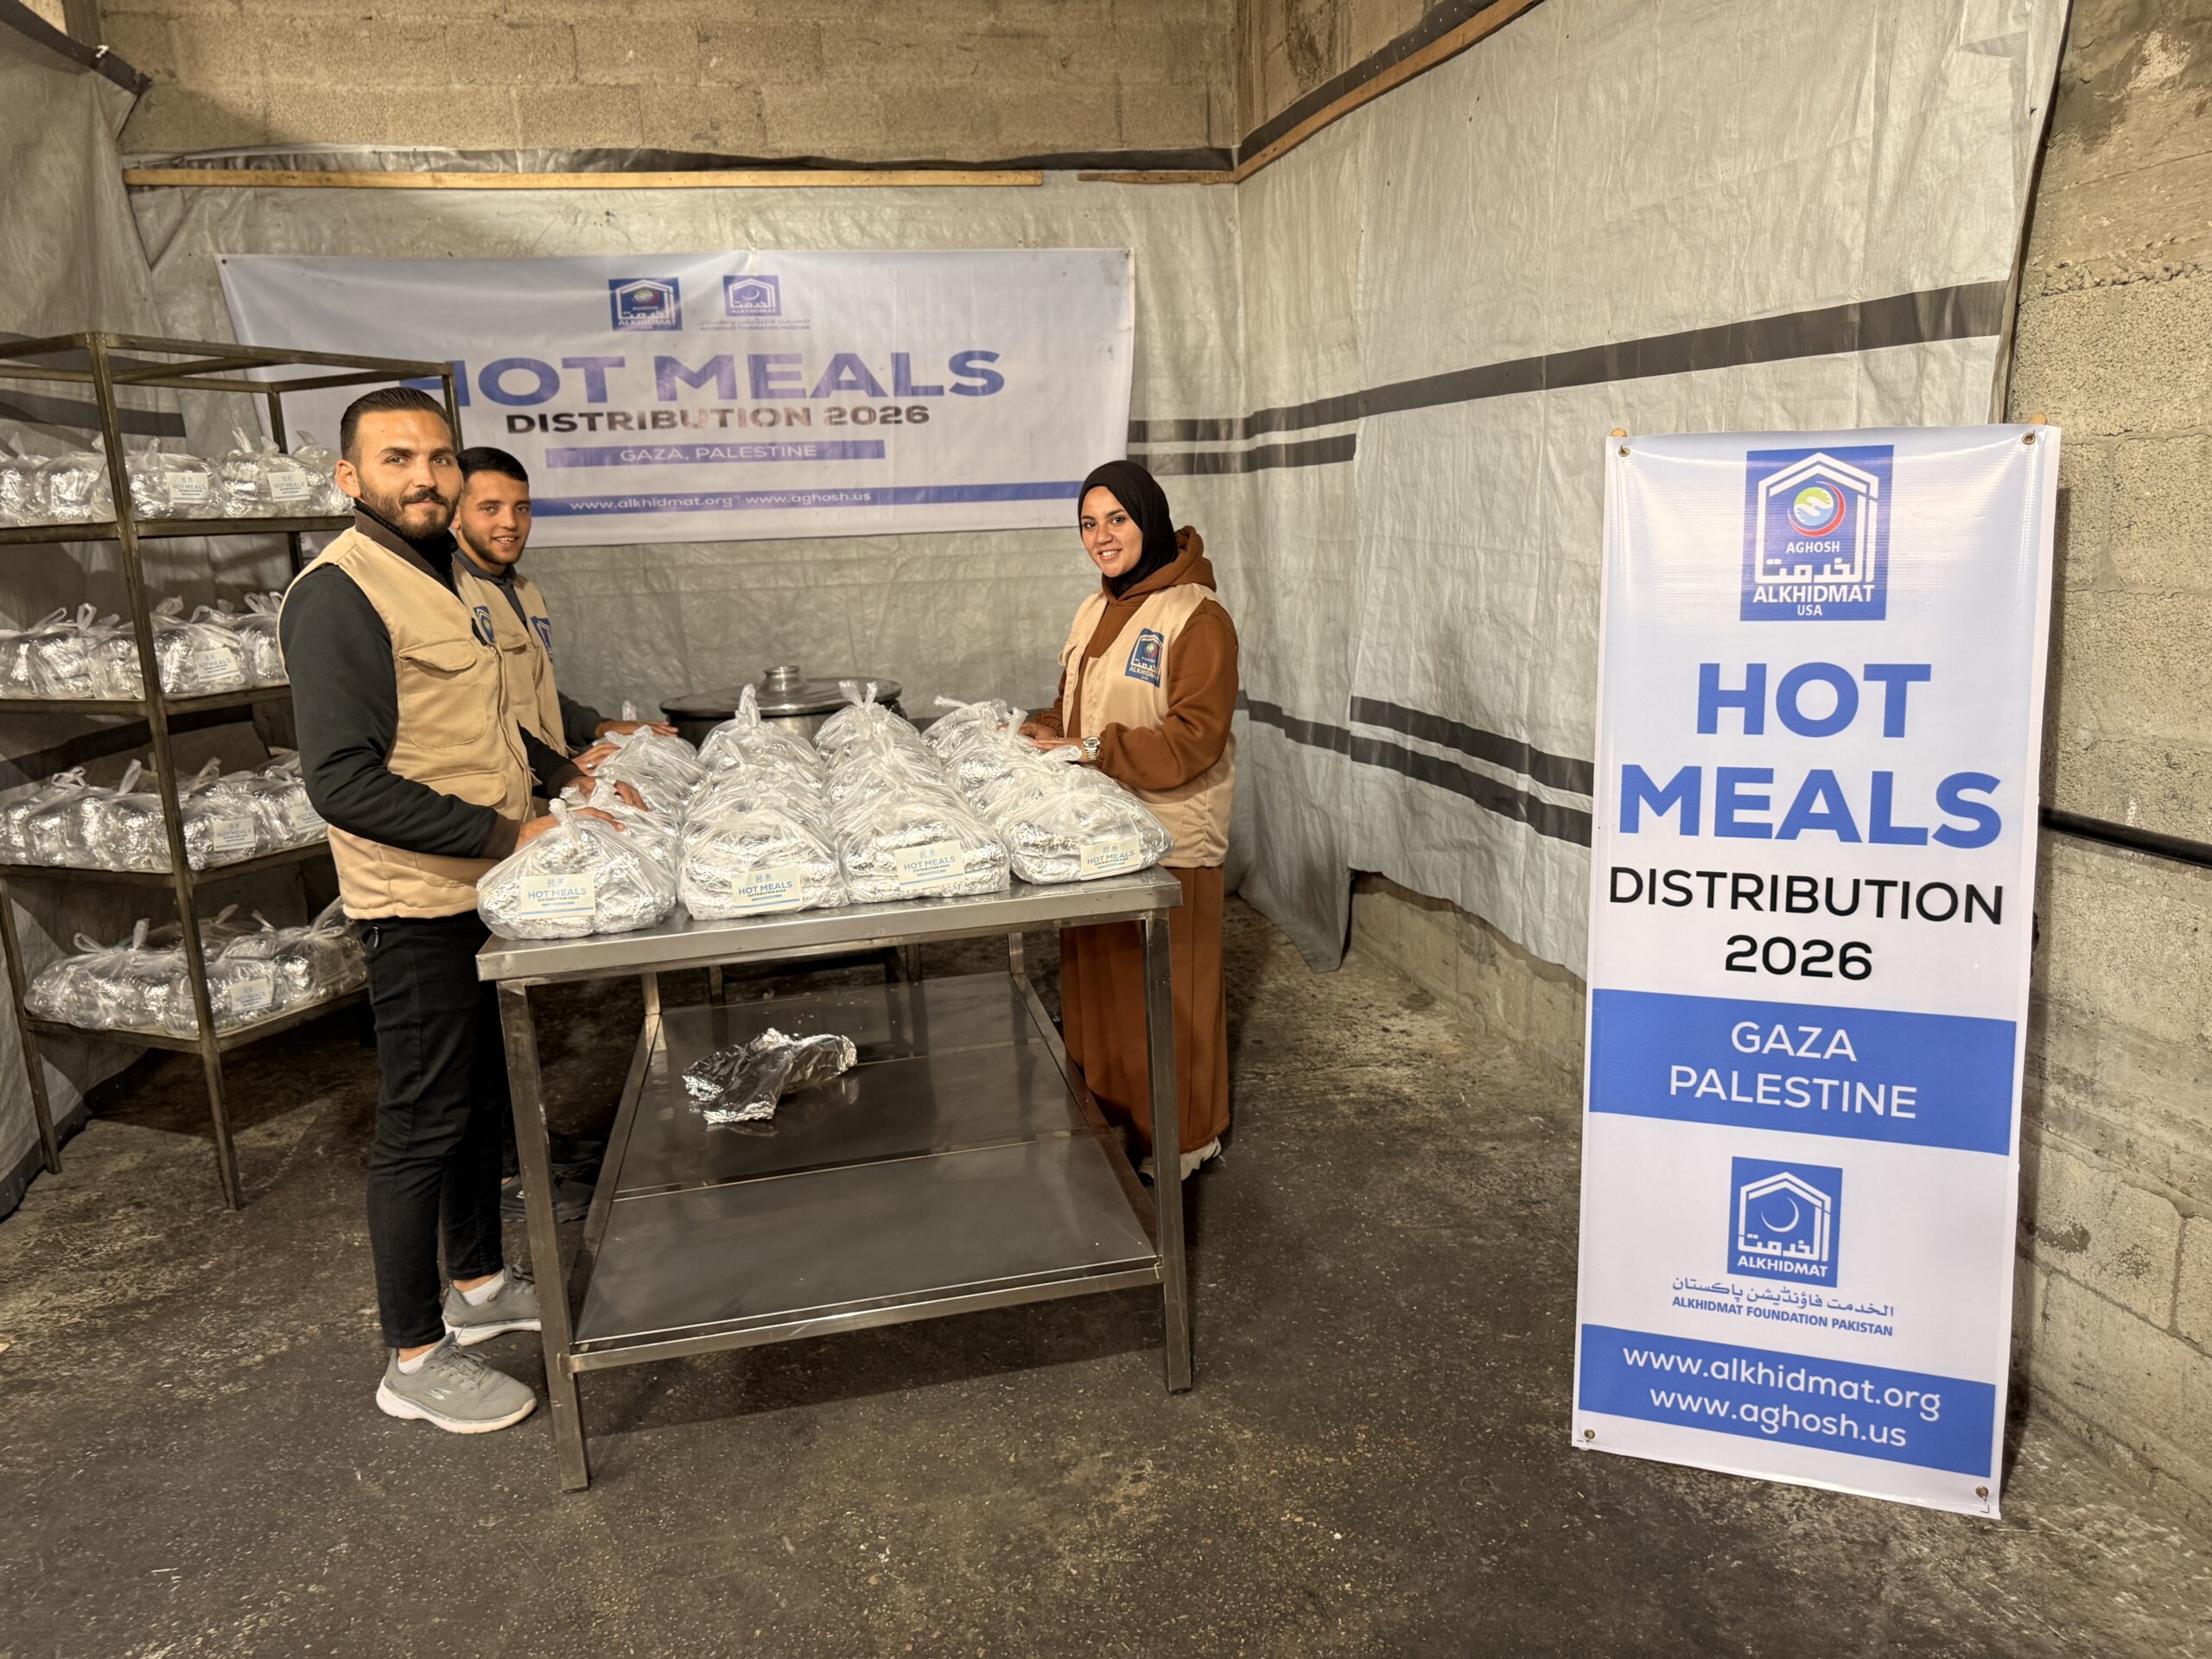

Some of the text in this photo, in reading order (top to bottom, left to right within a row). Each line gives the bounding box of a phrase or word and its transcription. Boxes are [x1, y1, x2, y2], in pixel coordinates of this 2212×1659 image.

[654, 350, 1005, 402] MEALS
[506, 404, 931, 434] DISTRIBUTION 2026
[696, 445, 817, 459] PALESTINE
[569, 491, 872, 511] www.alkhidmat.org www.aghosh.us
[1785, 541, 1840, 554] AGHOSH
[1752, 585, 1875, 603] ALKHIDMAT
[1796, 605, 1823, 616] USA
[1696, 661, 1931, 738] HOT
[1619, 764, 2002, 849] MEALS
[904, 855, 956, 871] HOT MEALS
[1087, 849, 1135, 865] HOT MEALS
[528, 887, 588, 899] HOT MEALS
[739, 881, 793, 895] HOT MEALS
[1609, 866, 2004, 925] DISTRIBUTION
[1725, 934, 1872, 981] 2026
[1731, 1020, 1858, 1062] GAZA
[1669, 1065, 1917, 1119] PALESTINE
[1737, 1255, 1828, 1277] ALKHIDMAT
[1672, 1296, 1893, 1337] ALKHIDMAT FOUNDATION PAKISTAN
[1623, 1348, 1942, 1422] www.alkhidmat.org
[1649, 1388, 1907, 1446] www.aghosh.us
